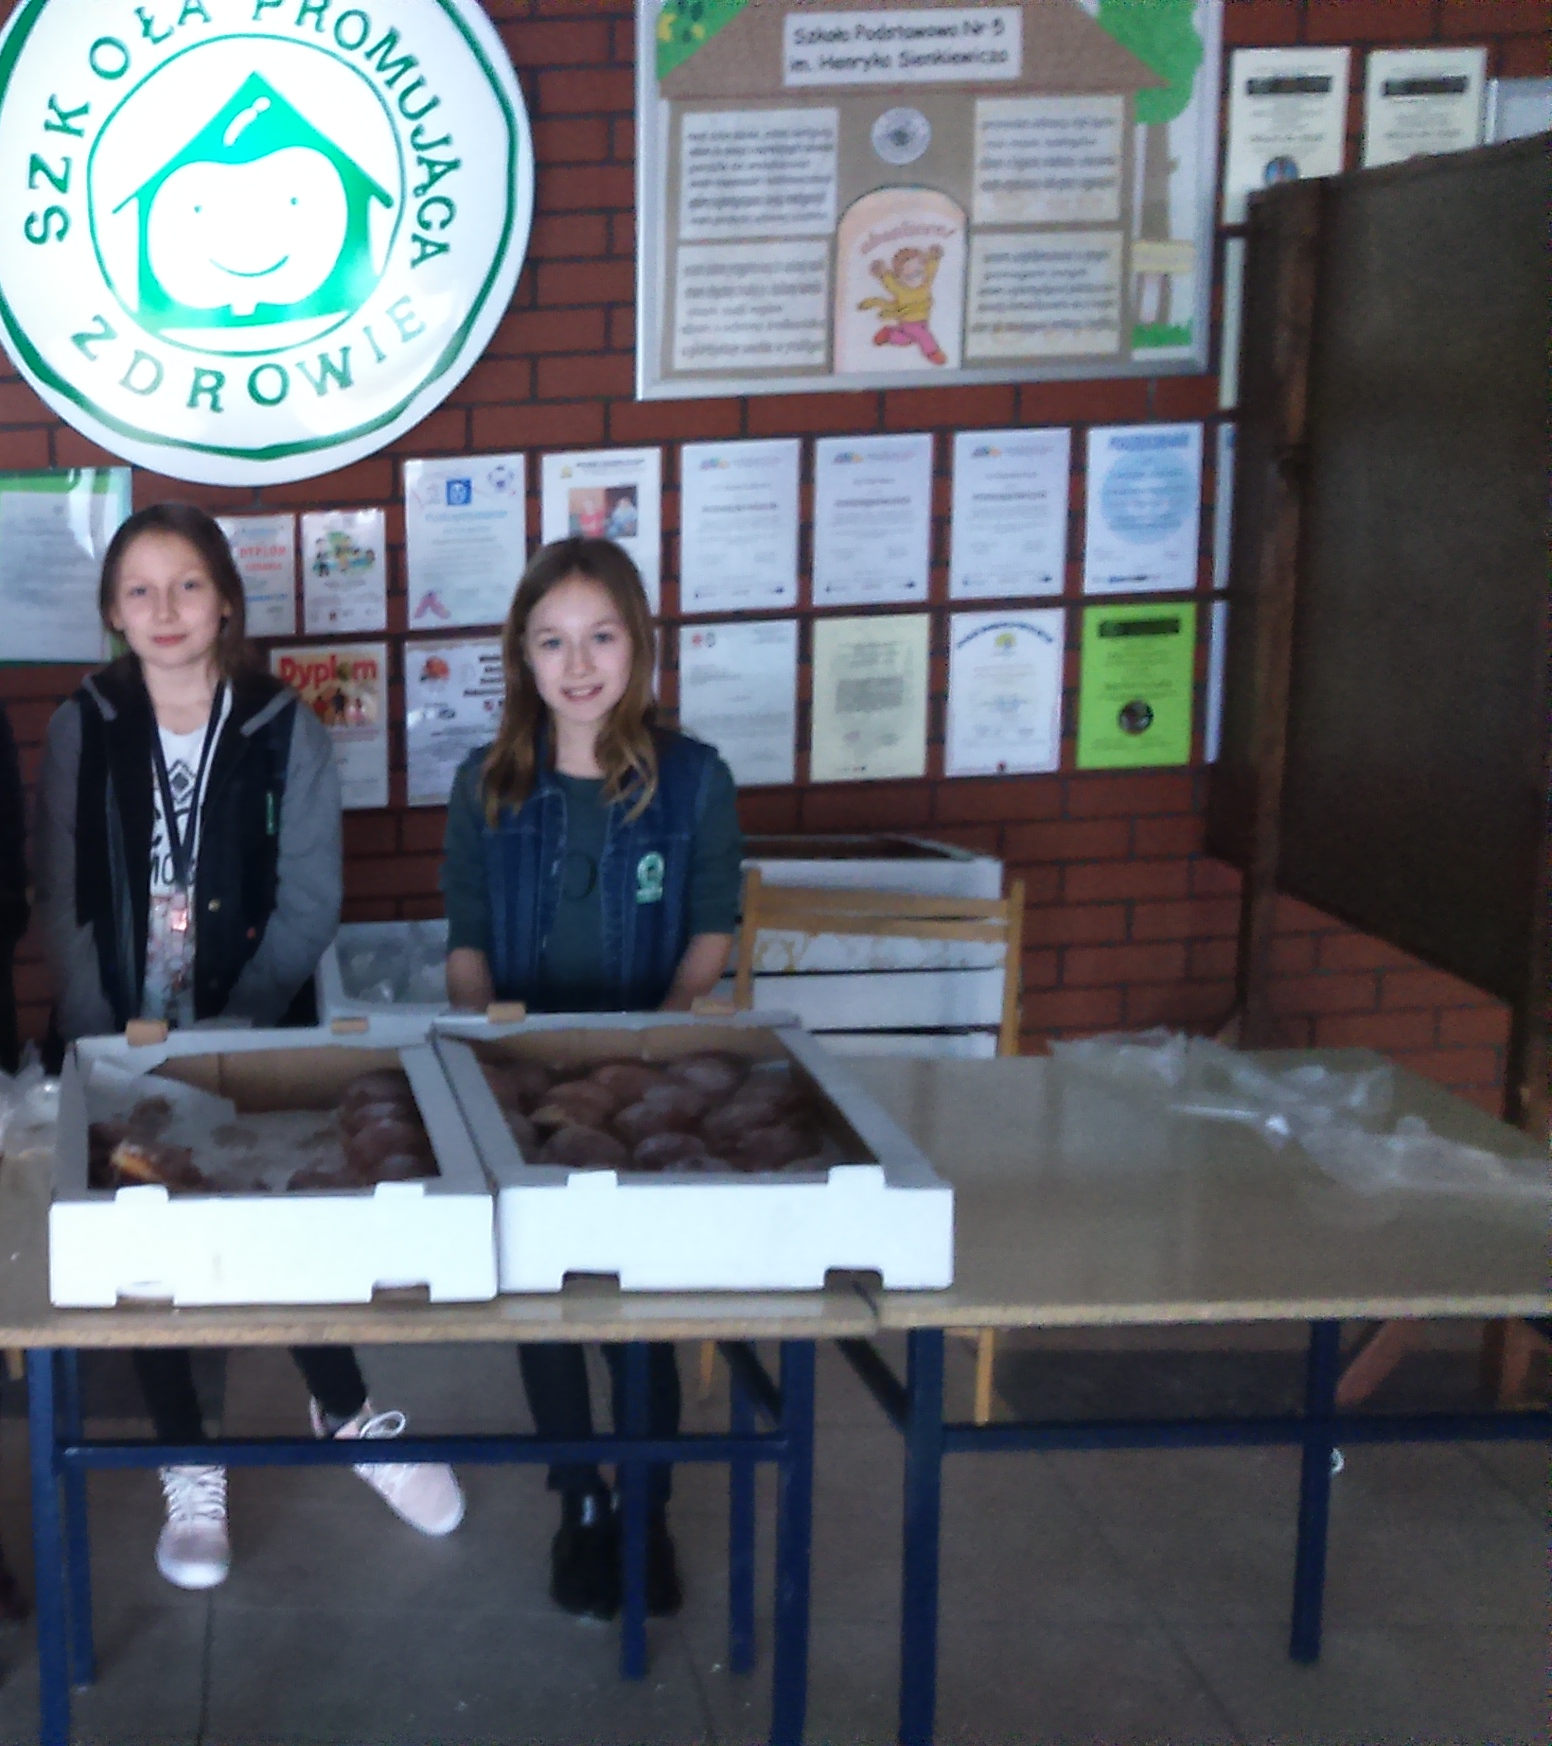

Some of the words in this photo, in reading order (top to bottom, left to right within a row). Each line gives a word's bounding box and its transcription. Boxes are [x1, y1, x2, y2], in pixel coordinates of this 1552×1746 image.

[23, 0, 213, 246] SZKOŁA
[70, 295, 427, 413] ZDROWIE
[280, 654, 378, 690] Dyplom
